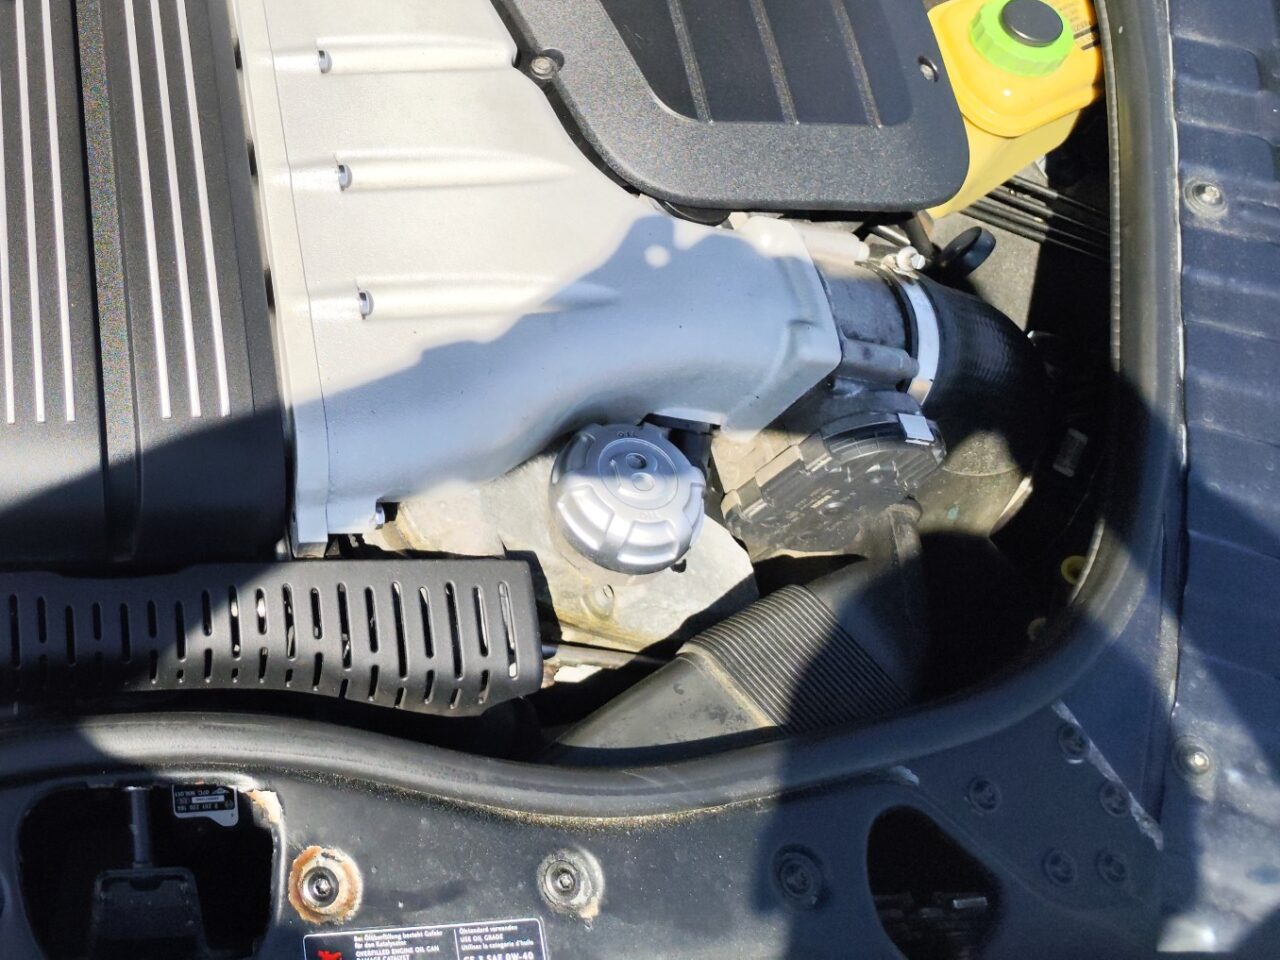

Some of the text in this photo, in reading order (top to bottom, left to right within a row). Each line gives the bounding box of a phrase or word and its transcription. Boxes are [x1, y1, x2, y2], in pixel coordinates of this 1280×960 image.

[484, 933, 504, 941] GRADE
[355, 948, 391, 958] OVERFILLED
[391, 947, 414, 955] ENGINE
